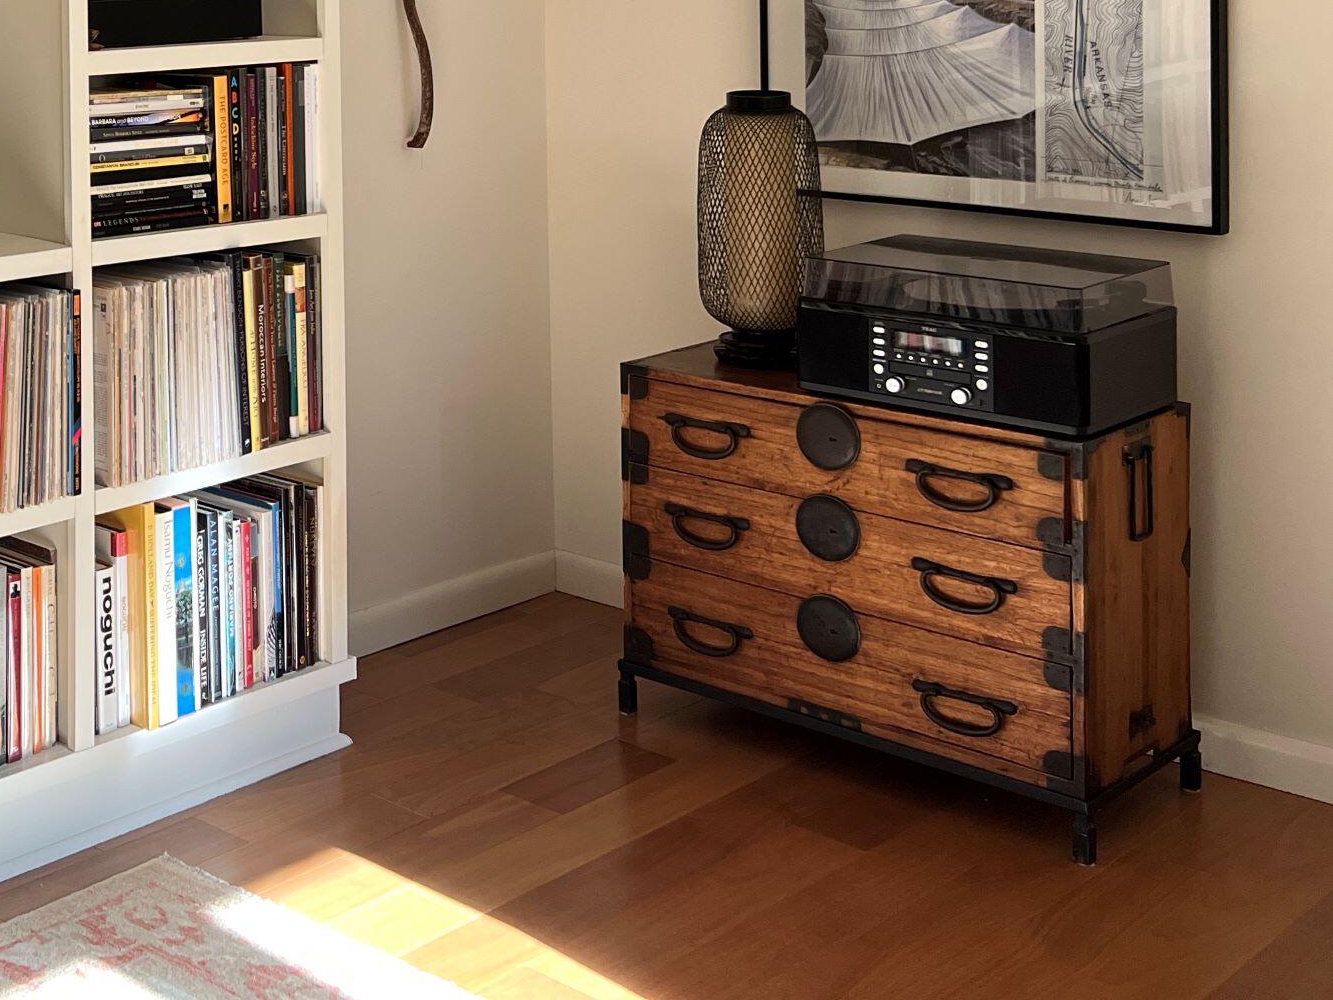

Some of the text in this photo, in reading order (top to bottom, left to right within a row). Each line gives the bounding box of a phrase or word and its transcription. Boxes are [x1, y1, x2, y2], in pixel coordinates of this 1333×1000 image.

[1063, 35, 1074, 73] RIVER
[1088, 39, 1113, 109] ARKANSAS
[220, 117, 228, 166] POSTCARD
[221, 168, 229, 185] AGE
[258, 304, 268, 403] Moroccan Interiors
[210, 520, 218, 557] ALAN
[163, 520, 174, 619] Isamu Noguchi
[198, 567, 206, 617] GORMAN
[211, 564, 220, 612] MAGEE
[100, 576, 116, 696] noguchi
